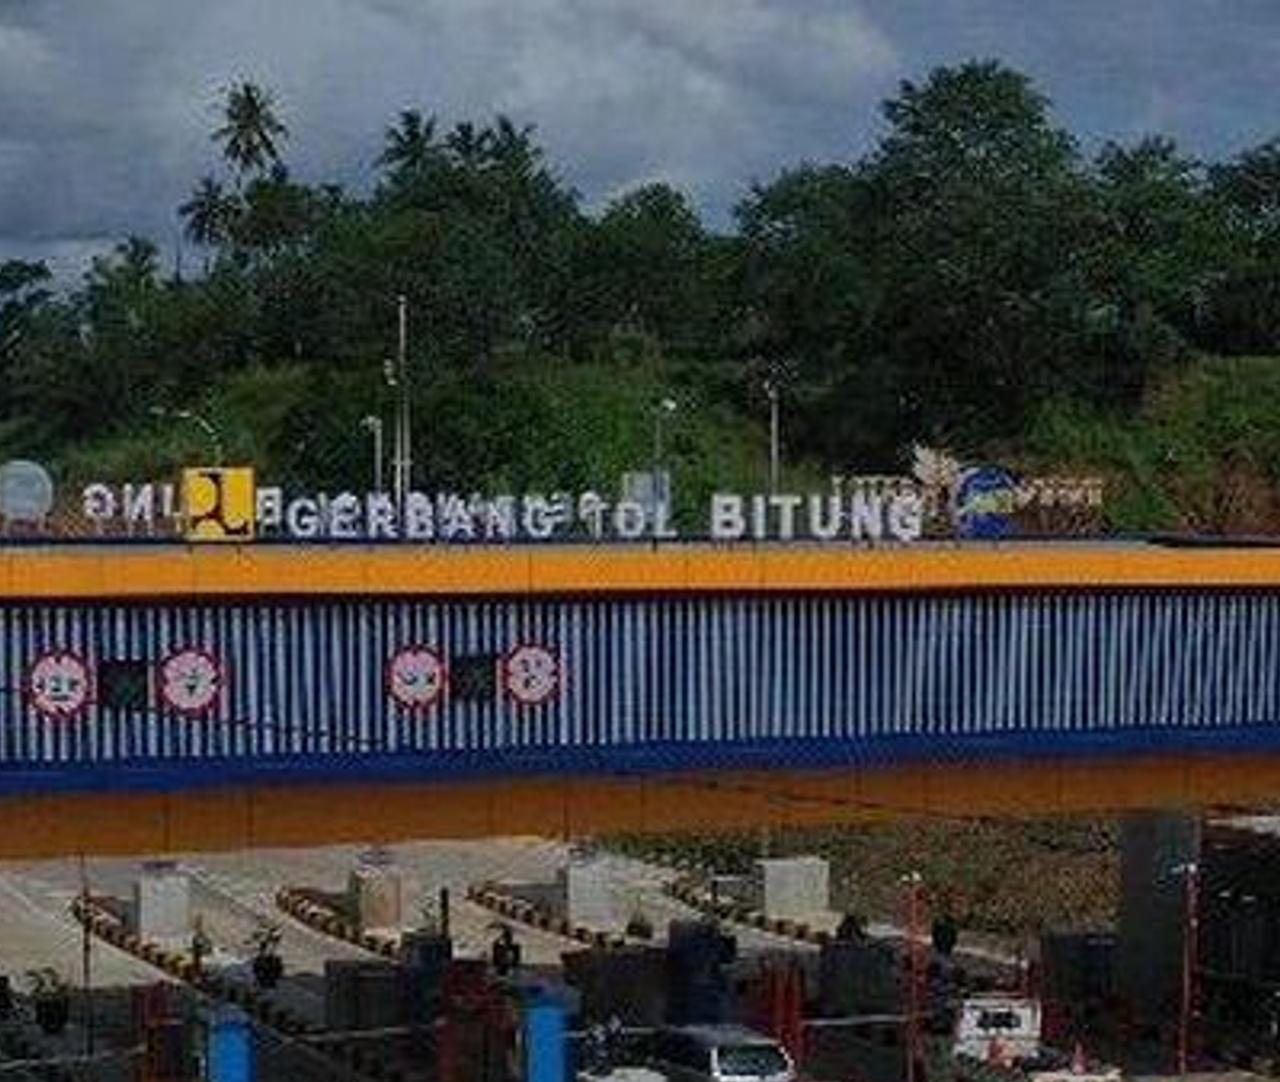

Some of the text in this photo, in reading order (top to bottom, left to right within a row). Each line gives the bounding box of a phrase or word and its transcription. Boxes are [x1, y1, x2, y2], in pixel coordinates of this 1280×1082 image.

[287, 493, 921, 541] GERBANG TOL BITUNG
